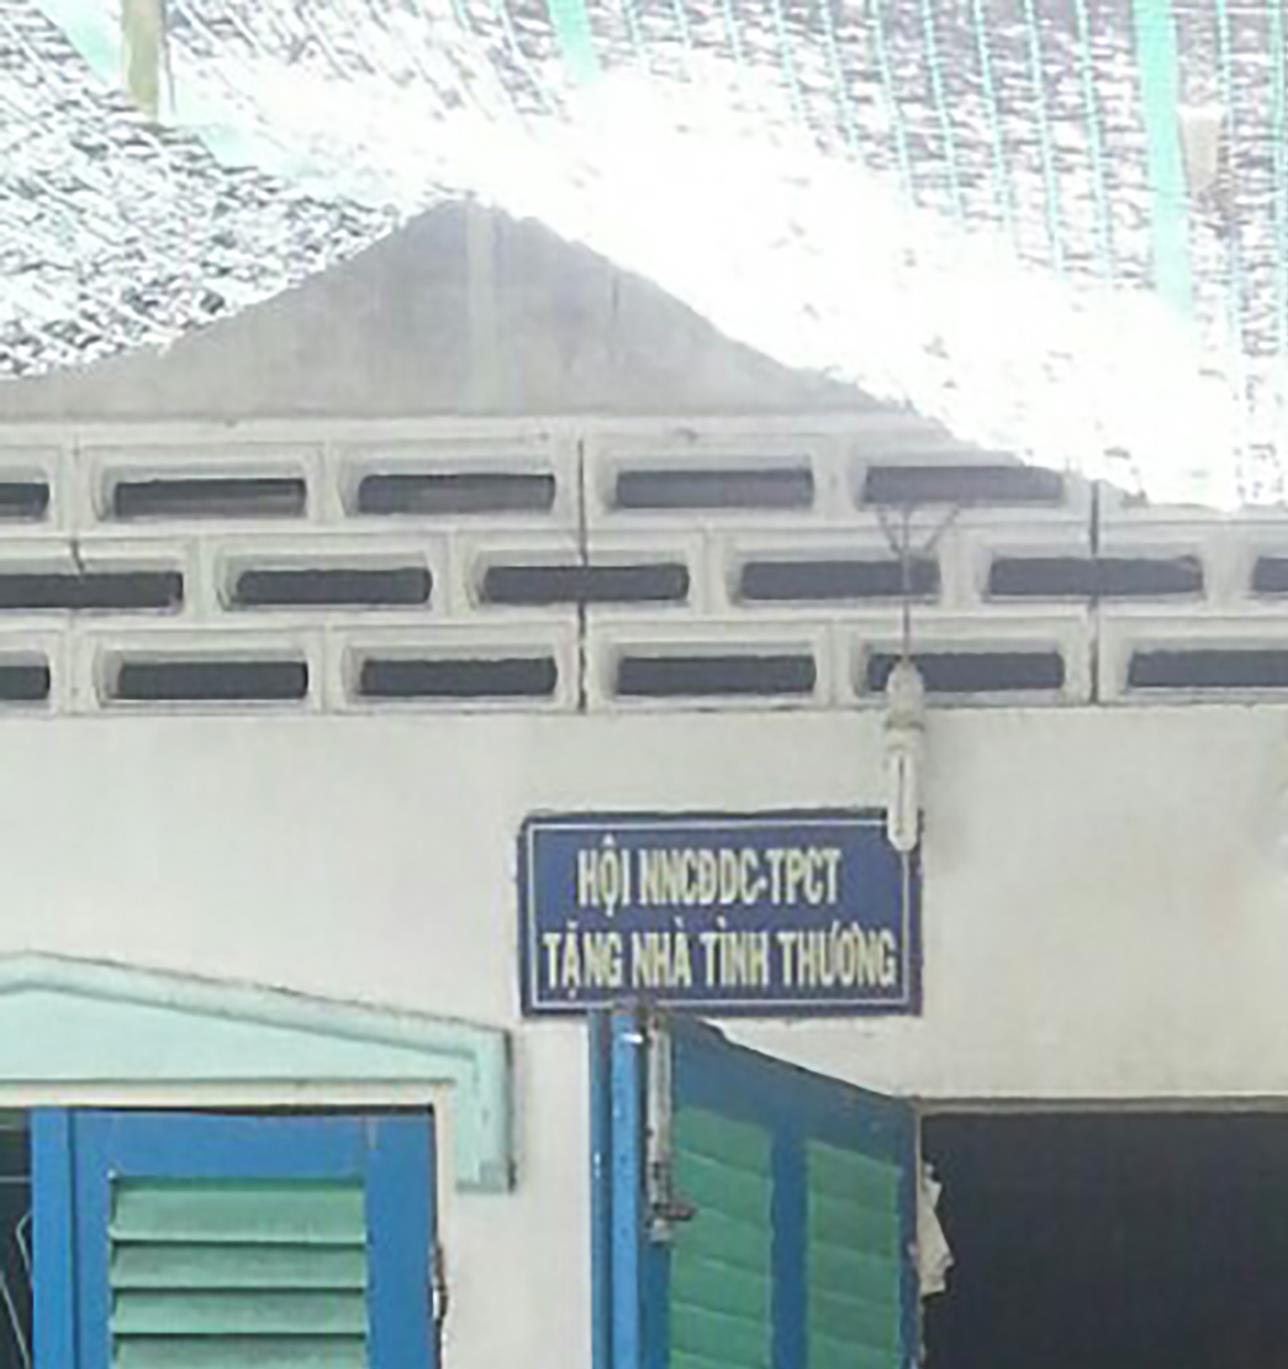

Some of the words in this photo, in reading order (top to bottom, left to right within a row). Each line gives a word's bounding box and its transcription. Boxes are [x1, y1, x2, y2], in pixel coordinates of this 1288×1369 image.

[577, 833, 630, 917] HỘI
[542, 920, 623, 998] TẶNG
[631, 916, 692, 987] NHÀ
[702, 915, 769, 988] TÌNH
